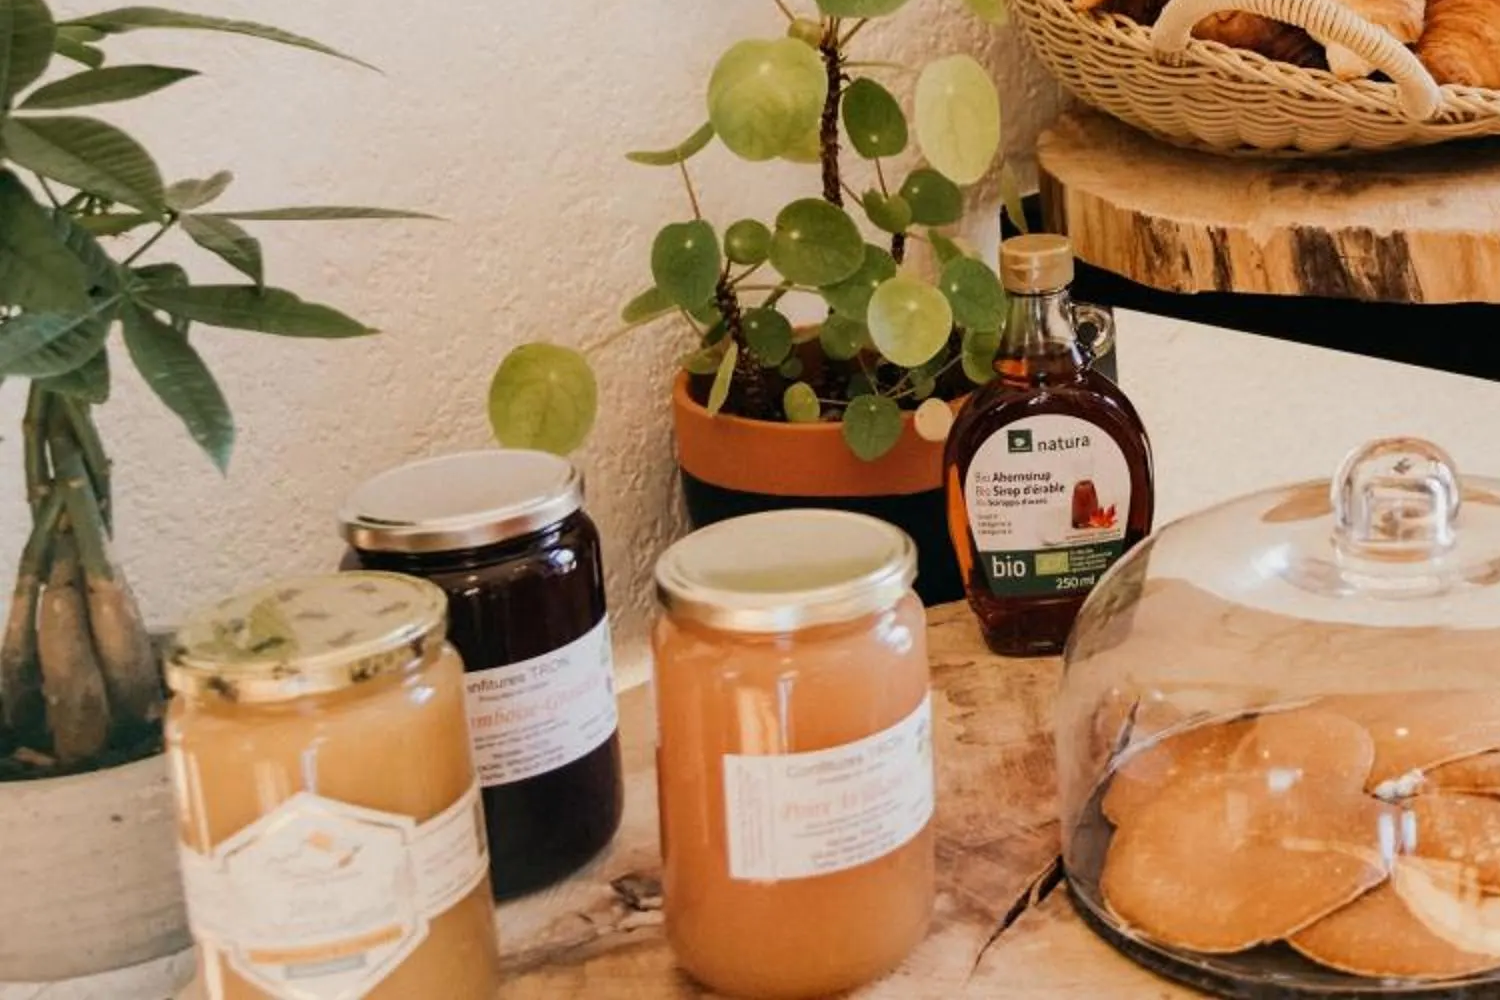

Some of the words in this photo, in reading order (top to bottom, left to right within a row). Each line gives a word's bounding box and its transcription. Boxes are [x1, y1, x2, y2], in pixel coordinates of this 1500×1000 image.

[1037, 435, 1090, 451] natura
[993, 485, 1020, 498] Sirop
[992, 556, 1026, 577] bio
[1056, 577, 1079, 590] 250
[1080, 573, 1095, 587] ml
